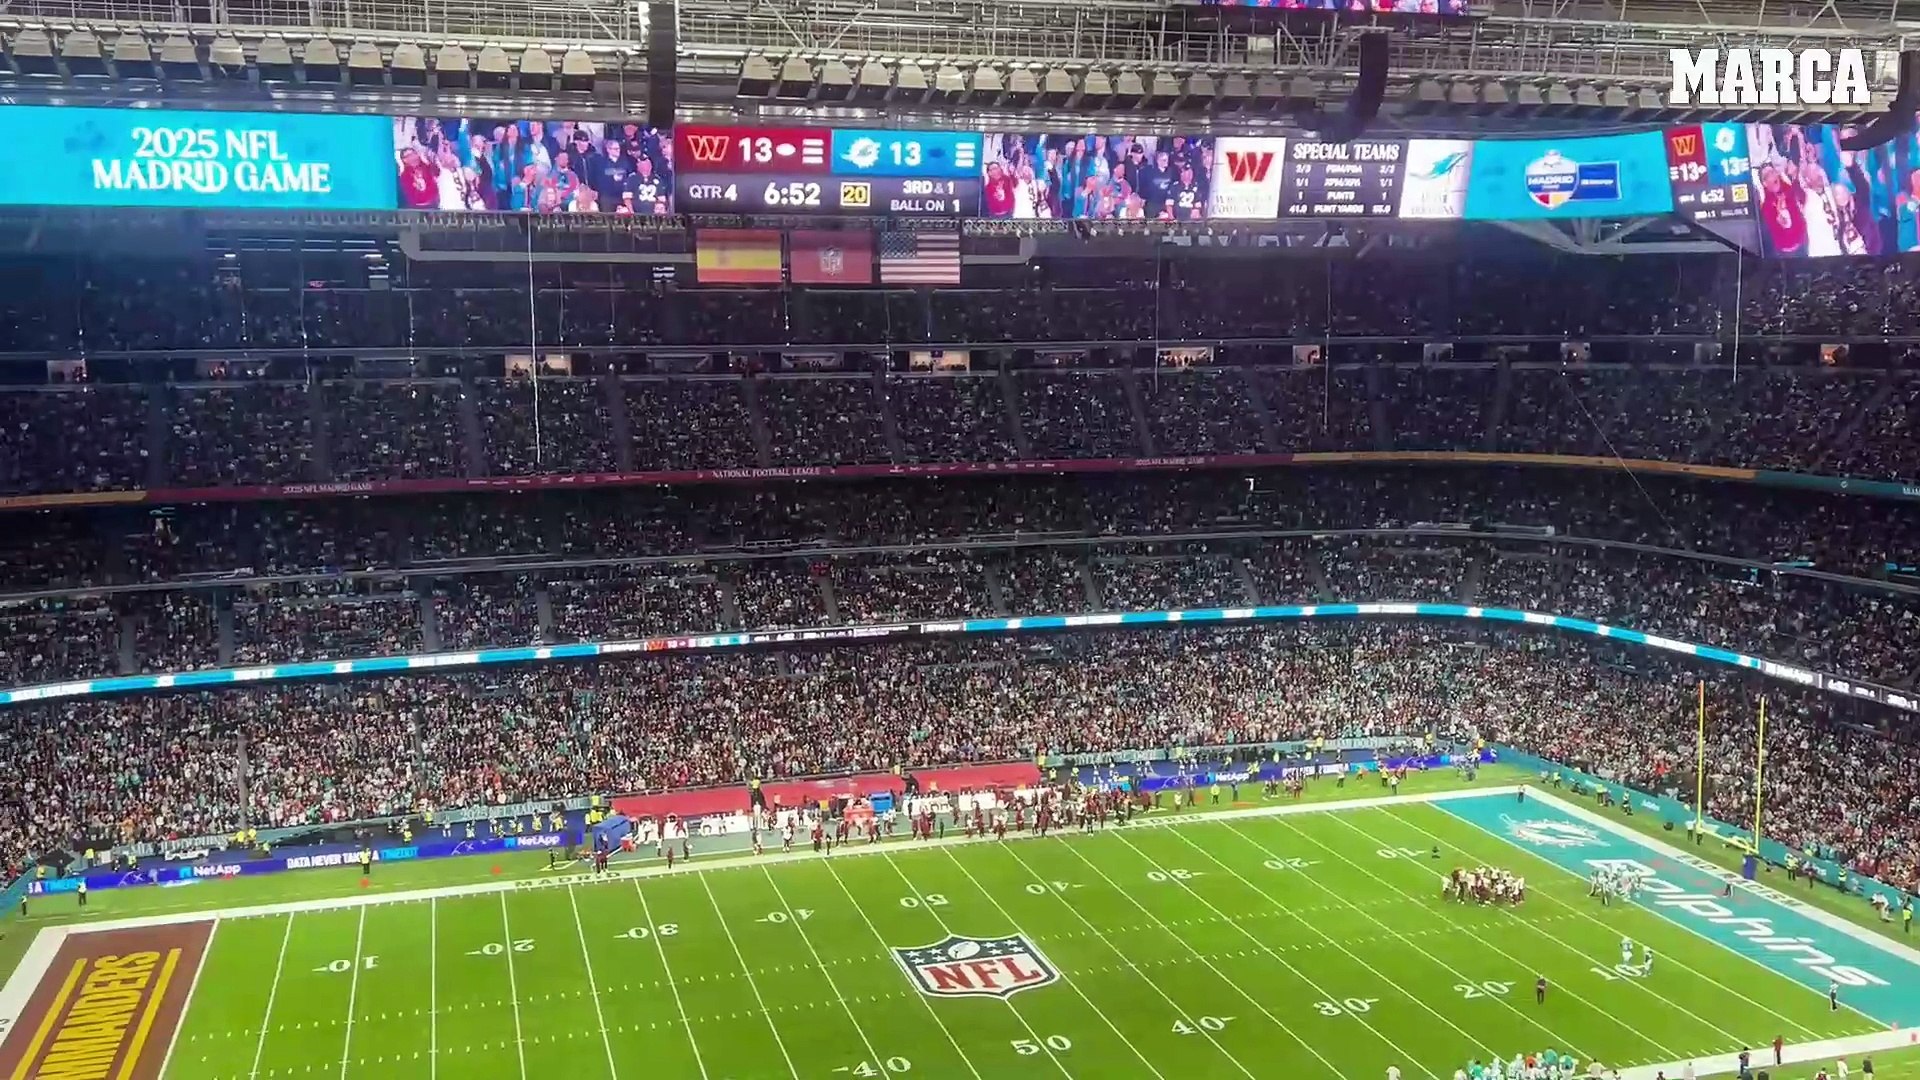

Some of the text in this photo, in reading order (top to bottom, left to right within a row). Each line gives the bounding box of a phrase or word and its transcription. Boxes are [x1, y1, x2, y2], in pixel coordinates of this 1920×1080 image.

[131, 127, 288, 161] 2025 NFL
[738, 137, 773, 163] 13
[1293, 143, 1400, 160] SPECIAL TEAMS
[890, 141, 922, 166] 13
[1680, 161, 1699, 182] 13
[1721, 156, 1741, 176] 13
[93, 159, 331, 192] MADRID GAME
[1528, 175, 1575, 185] MADRID
[639, 184, 657, 201] 32
[690, 184, 738, 201] QTR 4
[764, 182, 822, 206] 6:52
[844, 185, 868, 203] 20
[903, 181, 934, 194] 3RD
[947, 183, 955, 194] 1
[890, 199, 961, 212] BALL ON 1
[711, 466, 820, 478] NATIONAL FOOTBALL LEAGUE
[1216, 772, 1250, 782] NetApp
[489, 804, 508, 817] NFL
[518, 834, 561, 846] NetApp
[287, 857, 311, 869] DATA
[311, 853, 342, 867] NEVER
[371, 849, 380, 861] A
[1263, 857, 1310, 871] 20
[193, 864, 241, 877] NetApp
[1147, 868, 1192, 882] 30
[1026, 880, 1071, 894] 40
[900, 893, 949, 909] 50
[767, 908, 816, 924] 40
[627, 923, 679, 939] 30
[484, 938, 536, 955] 20
[328, 954, 381, 973] 10
[922, 957, 1044, 991] NFL
[1454, 979, 1508, 999] 20
[1313, 996, 1371, 1017] 30
[1171, 1014, 1226, 1036] 40
[1010, 1034, 1072, 1055] 50
[852, 1056, 912, 1077] 40
